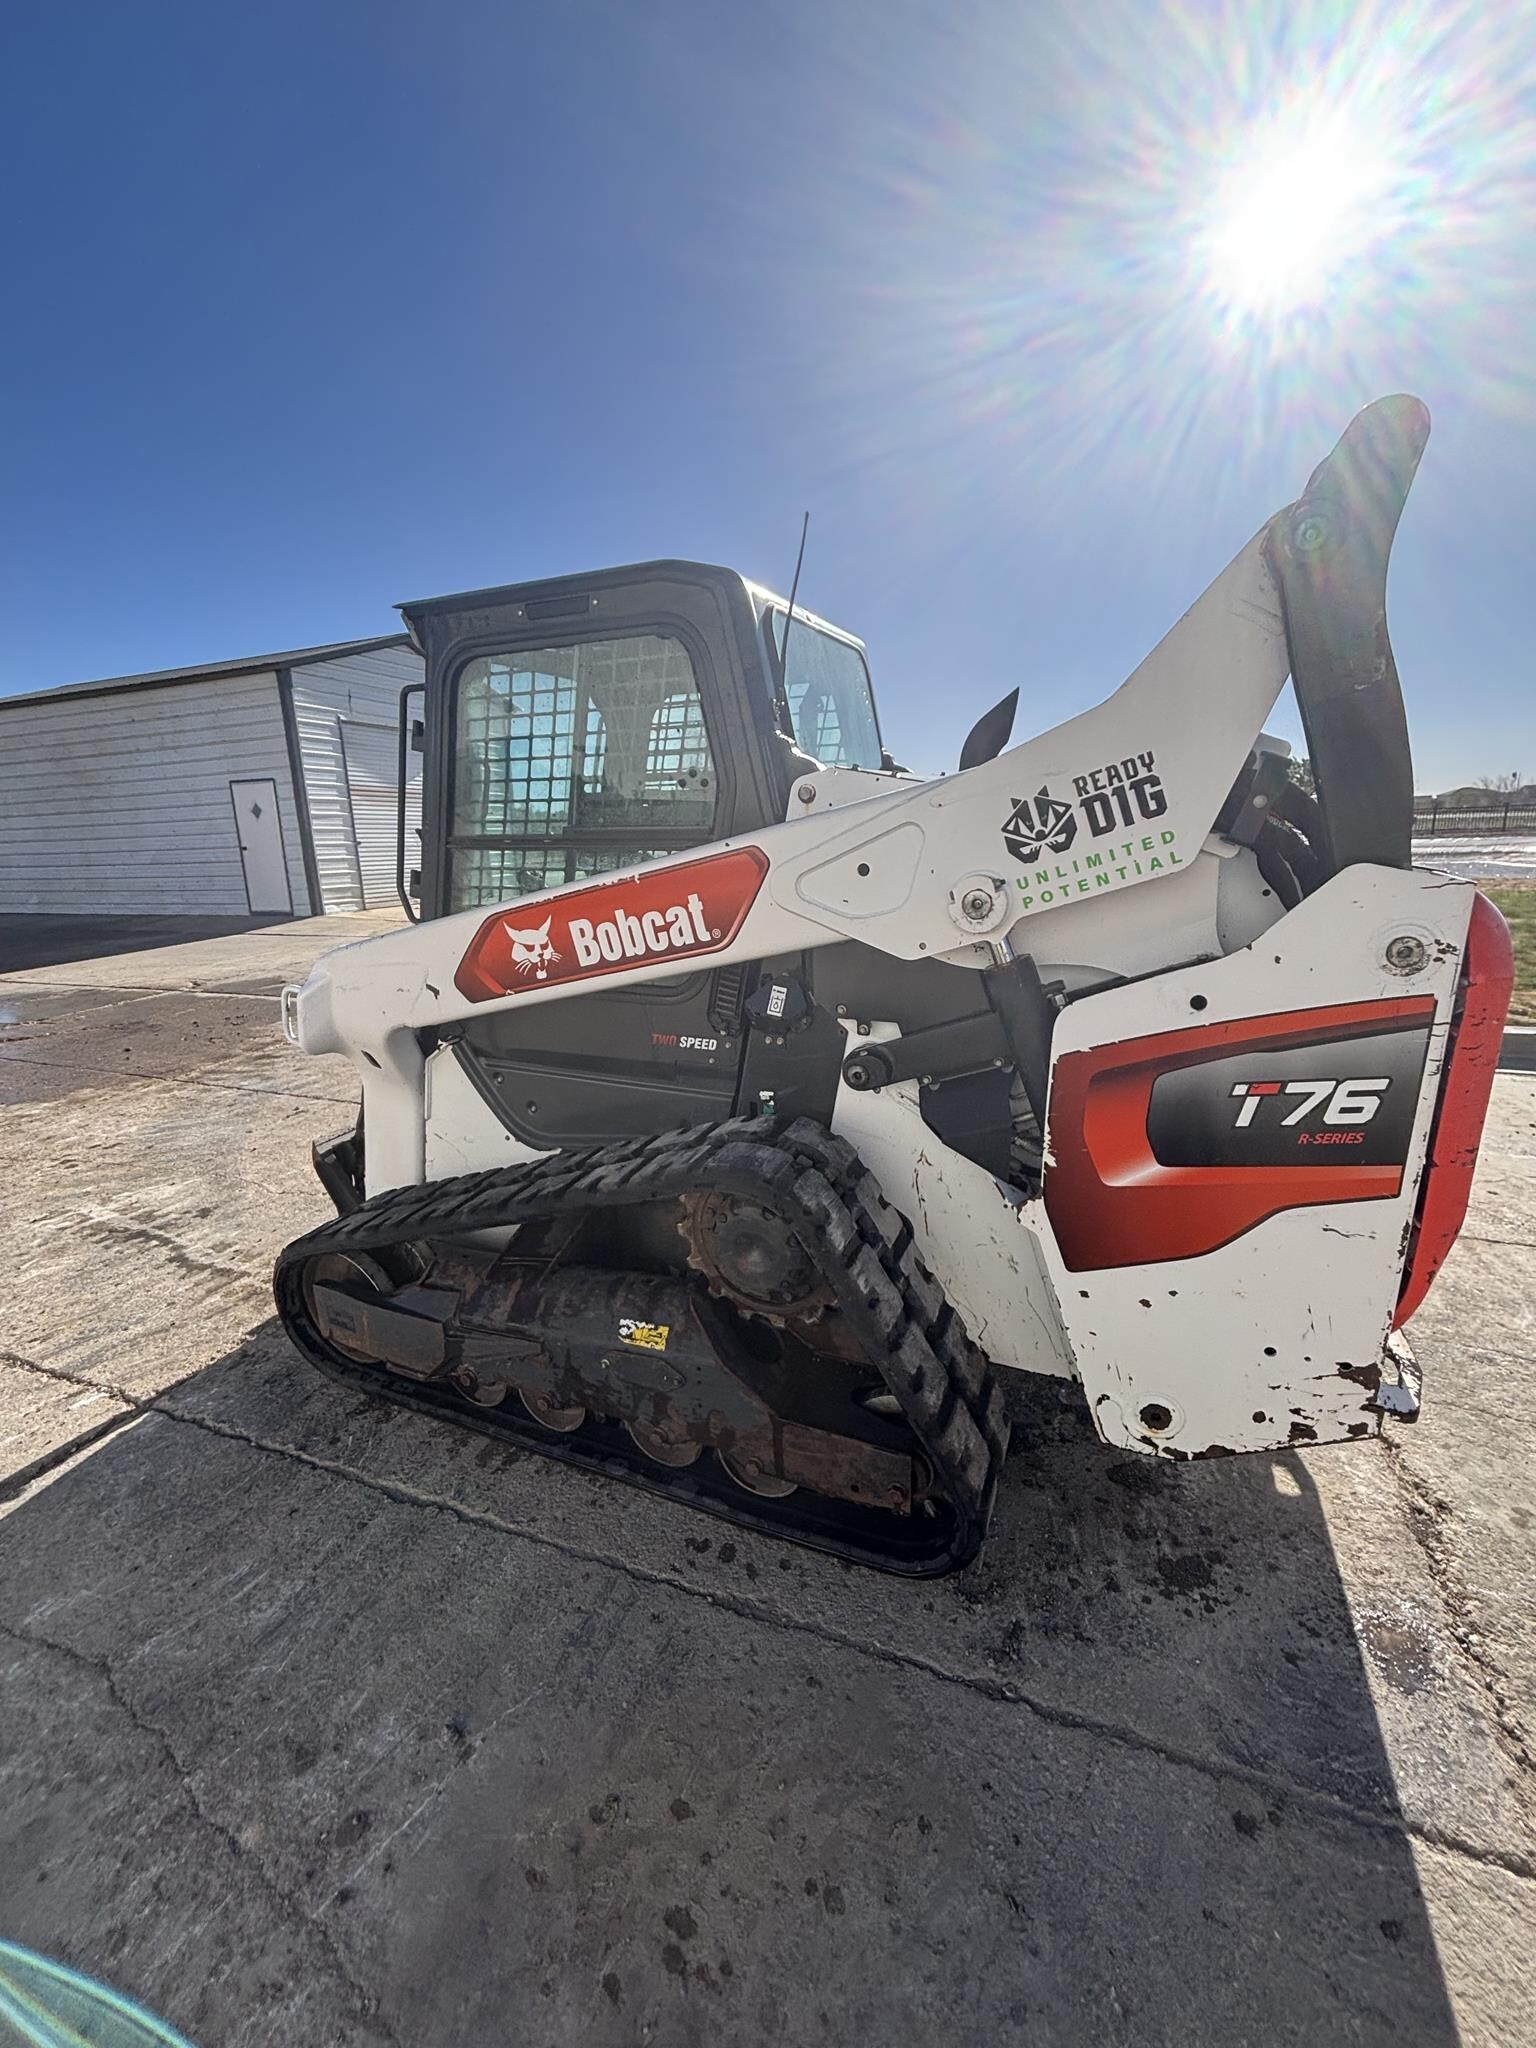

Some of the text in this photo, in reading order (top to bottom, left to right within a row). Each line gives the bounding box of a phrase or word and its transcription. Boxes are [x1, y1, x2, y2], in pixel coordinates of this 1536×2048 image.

[1072, 751, 1155, 797] READY
[1079, 774, 1168, 838] DIG
[1016, 831, 1175, 890] UNLIMITED
[1022, 851, 1183, 909] POTENTIAL
[568, 893, 712, 967] Bobcat
[651, 1033, 718, 1051] TWO SPEED
[1231, 1078, 1391, 1127] T76
[1298, 1132, 1365, 1145] R-SERIES
